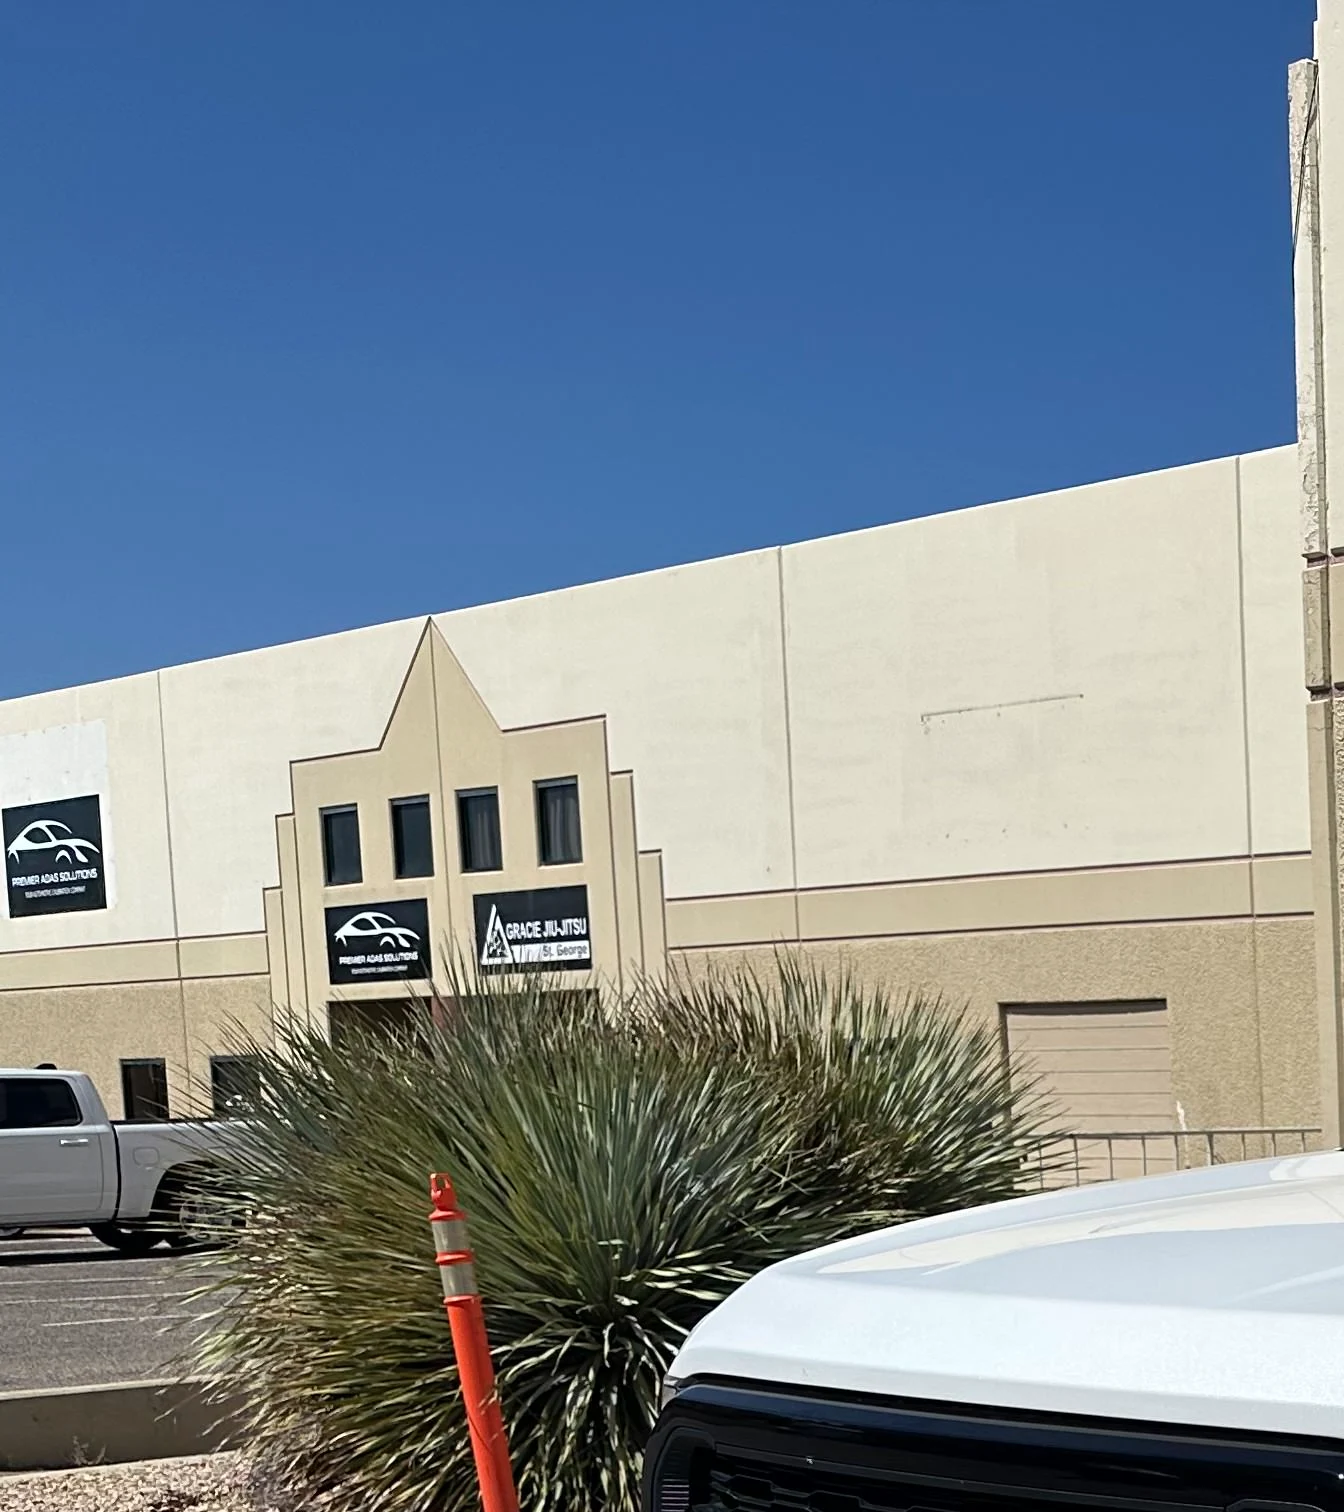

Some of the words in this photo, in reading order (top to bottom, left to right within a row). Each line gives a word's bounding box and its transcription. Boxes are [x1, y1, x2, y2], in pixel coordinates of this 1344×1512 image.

[12, 875, 40, 887] PREMIER
[40, 872, 59, 884] ADAS
[59, 868, 98, 882] SOLUTIONS
[505, 921, 542, 940] GRACIE
[543, 917, 587, 938] JIU-JITSU
[556, 944, 588, 958] George
